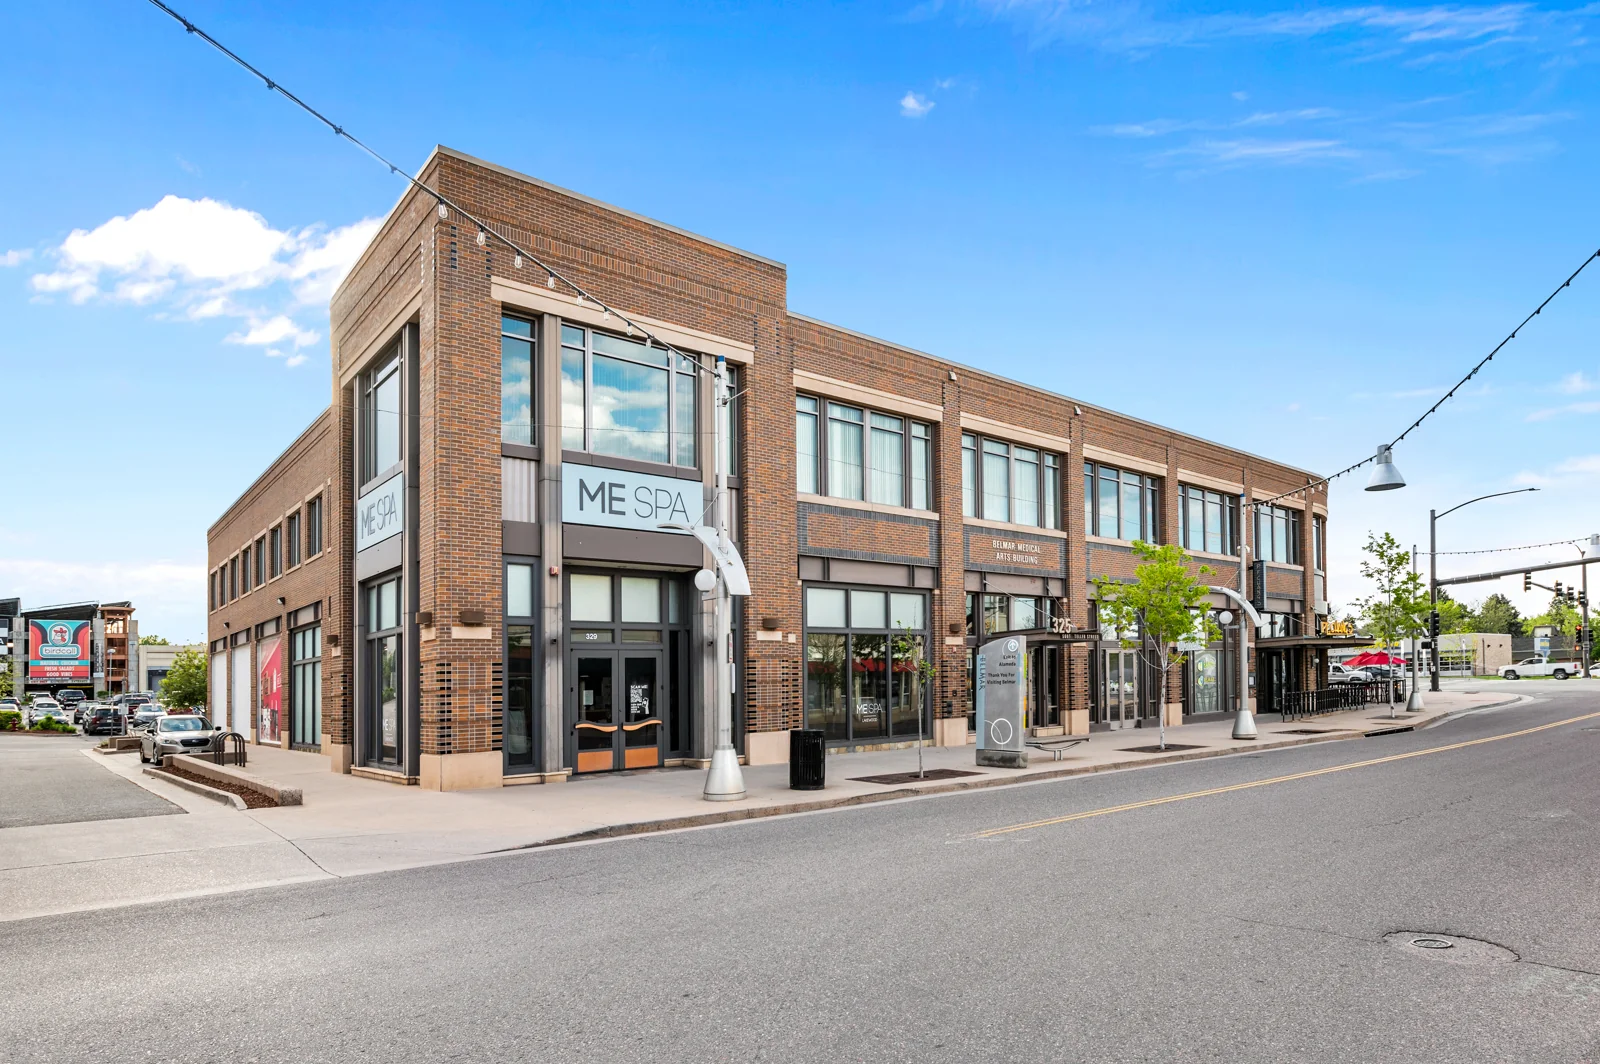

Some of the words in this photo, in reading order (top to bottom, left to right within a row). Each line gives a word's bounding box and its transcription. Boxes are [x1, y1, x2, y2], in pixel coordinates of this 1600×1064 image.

[579, 478, 626, 516] ME
[634, 486, 690, 523] SPA
[361, 502, 376, 540] ME
[377, 491, 398, 531] SPA
[992, 540, 1015, 551] BELMAR
[1017, 543, 1041, 554] MEDICAL
[996, 552, 1011, 562] ARTS
[1012, 554, 1038, 565] BUILDING
[1052, 617, 1072, 634] 325
[856, 704, 868, 714] ME
[869, 703, 883, 714] SPA
